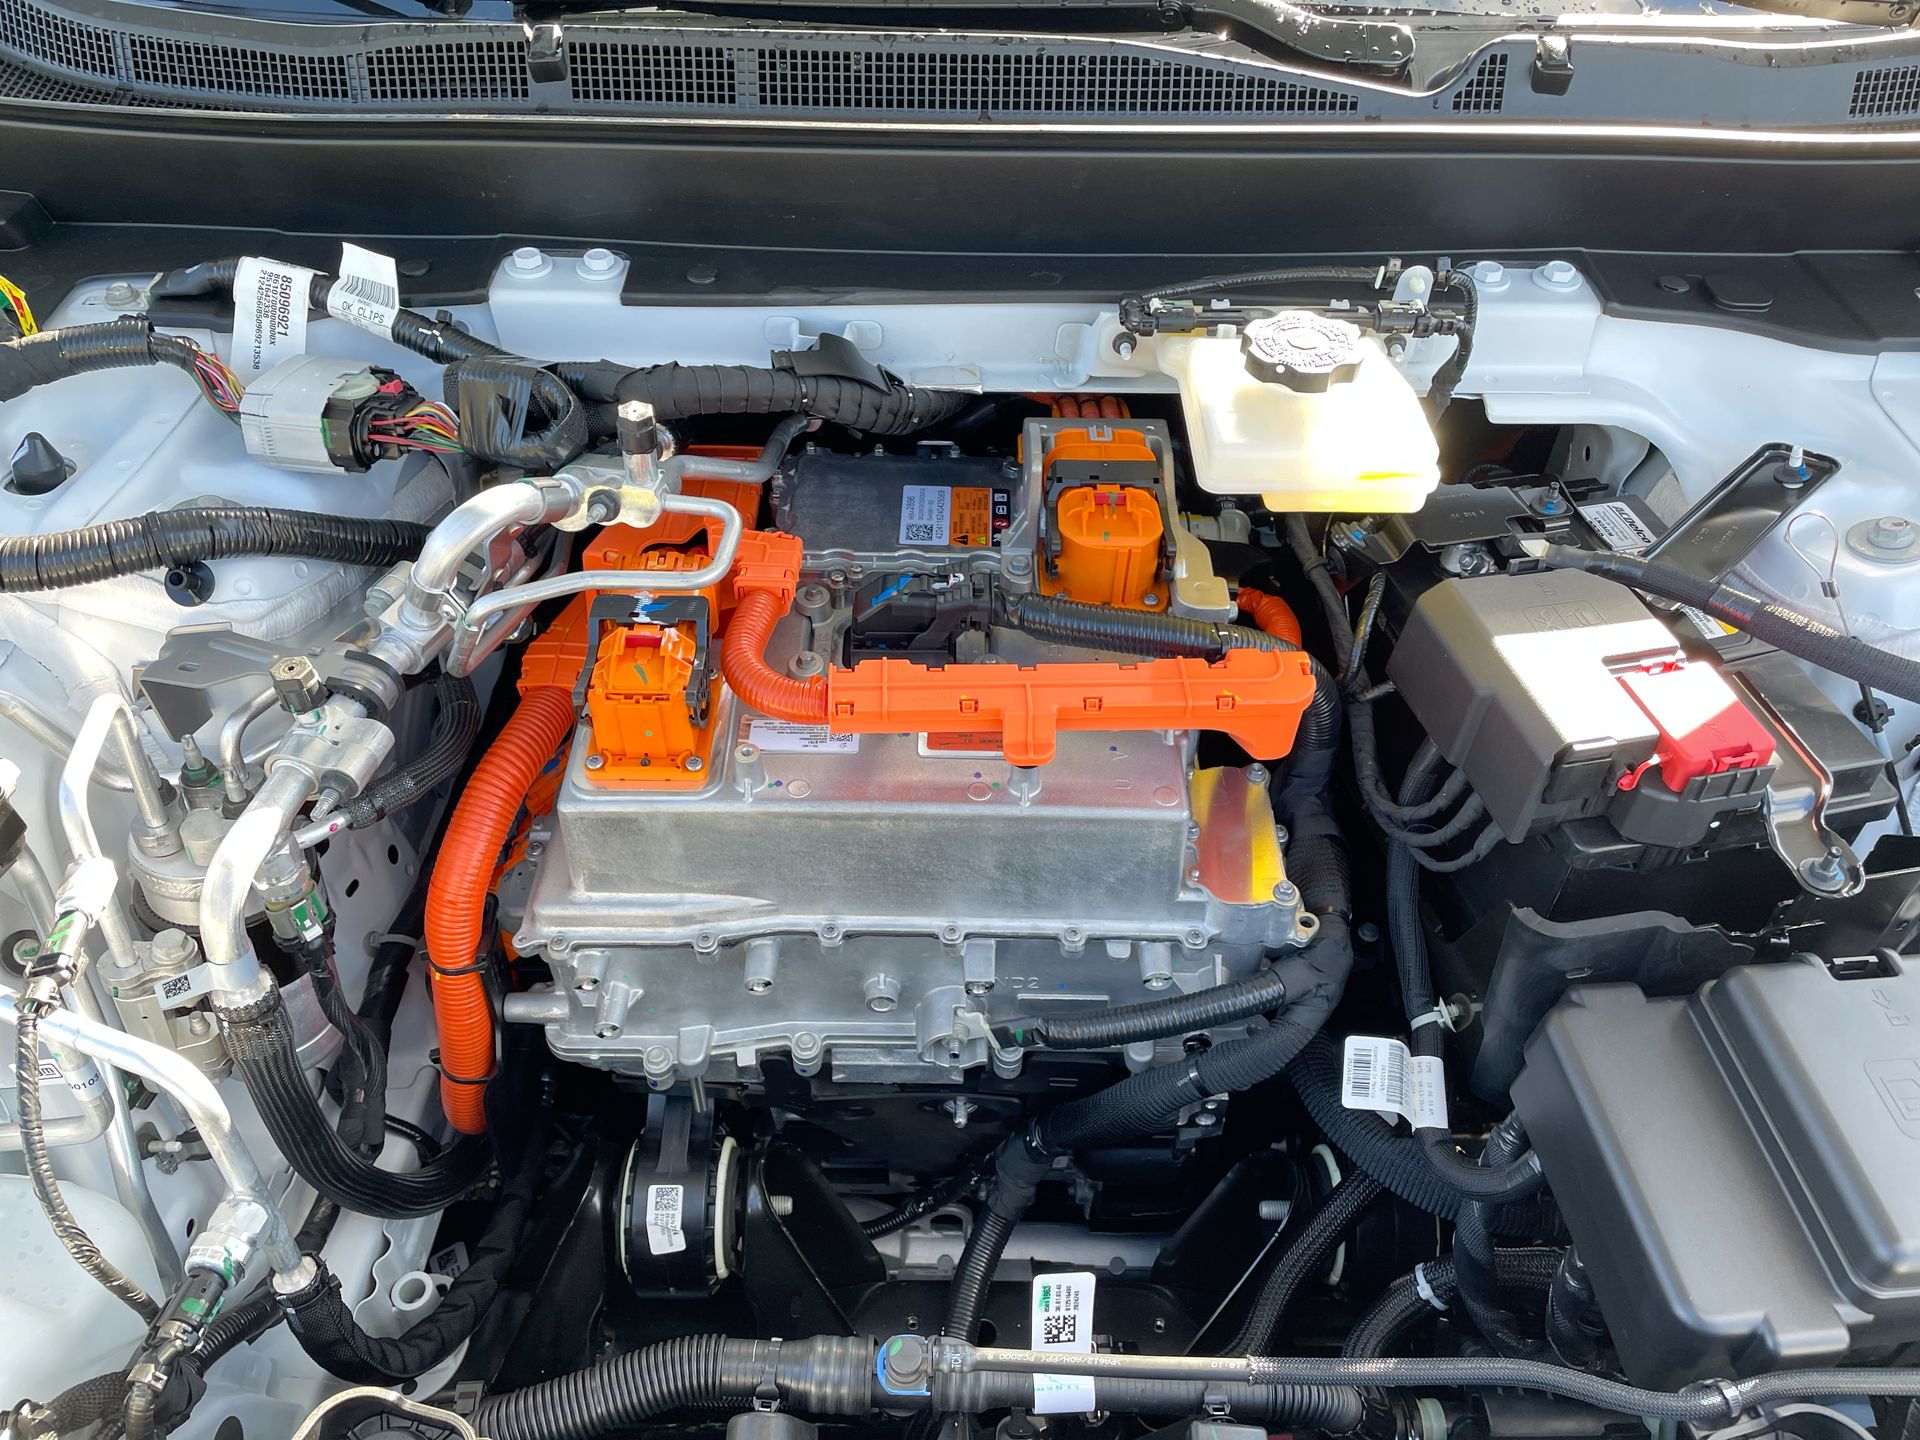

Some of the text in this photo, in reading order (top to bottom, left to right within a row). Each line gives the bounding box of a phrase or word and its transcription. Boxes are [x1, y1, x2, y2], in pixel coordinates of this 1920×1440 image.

[263, 272, 274, 319] 951642338
[277, 275, 293, 337] 85096921
[341, 301, 353, 313] OK
[357, 306, 385, 324] CLIPS
[1612, 505, 1651, 544] ACDelco
[951, 1353, 961, 1368] TCN
[999, 1352, 1035, 1362] PC2000
